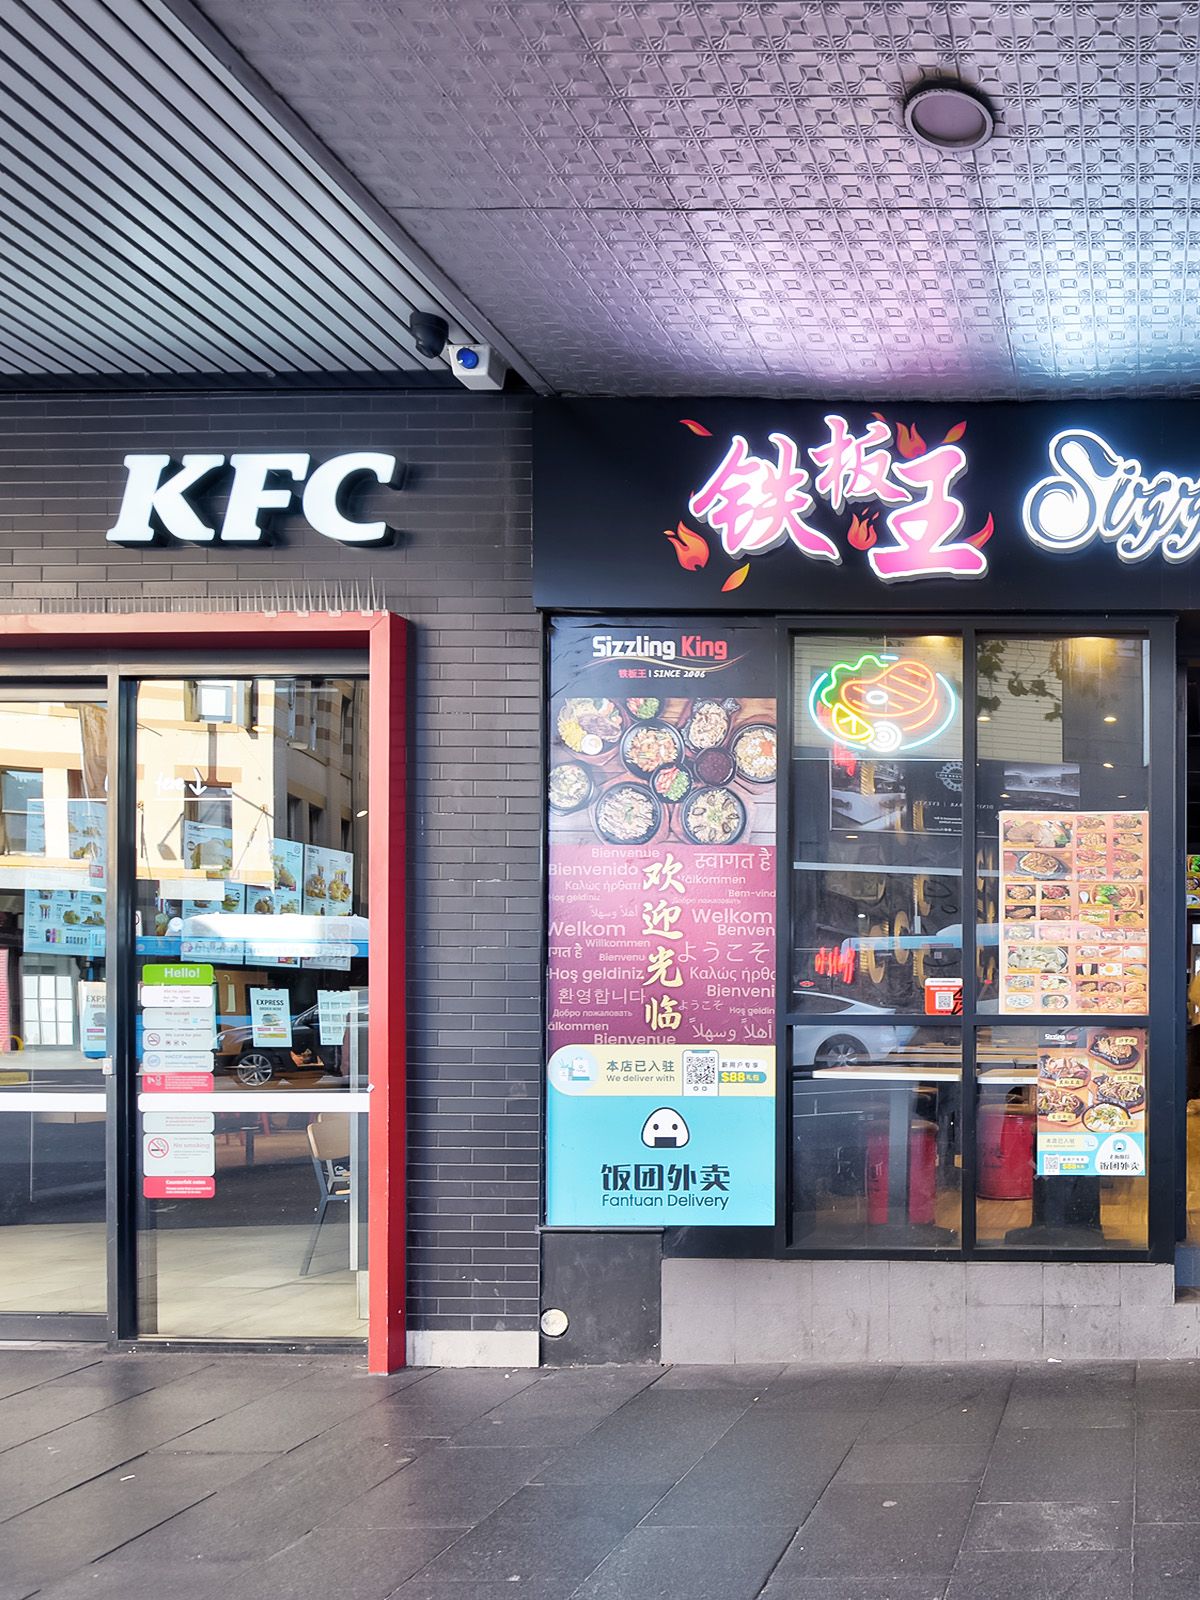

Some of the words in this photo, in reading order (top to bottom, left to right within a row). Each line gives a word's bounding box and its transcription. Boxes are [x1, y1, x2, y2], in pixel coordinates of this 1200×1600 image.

[106, 451, 401, 546] KFC
[688, 414, 988, 581] 铁板王
[592, 635, 676, 660] Sizzling
[681, 635, 728, 660] King
[653, 669, 681, 678] SINCE
[683, 670, 706, 678] 2006
[591, 848, 660, 858] Bienvenue
[548, 863, 639, 876] Bienvenido
[692, 907, 773, 924] Welkom
[717, 924, 775, 937] Benven
[585, 939, 650, 948] Willkommen
[642, 853, 686, 1031] 欢迎光临
[678, 941, 770, 964] ようこそ
[164, 967, 200, 978] Hello!
[549, 967, 578, 984] Hoş
[582, 967, 645, 984] geldiniz
[558, 988, 646, 1005] 환영합니다
[707, 984, 775, 998] Bienveni
[594, 1033, 677, 1045] Bienvenue
[606, 1060, 675, 1072] 本店已入驻
[606, 1074, 621, 1082] We
[622, 1074, 655, 1082] deliver
[656, 1074, 675, 1082] with
[601, 1164, 730, 1192] 饭团外卖
[602, 1194, 663, 1207] Fantuan
[668, 1194, 729, 1210] Delivery
